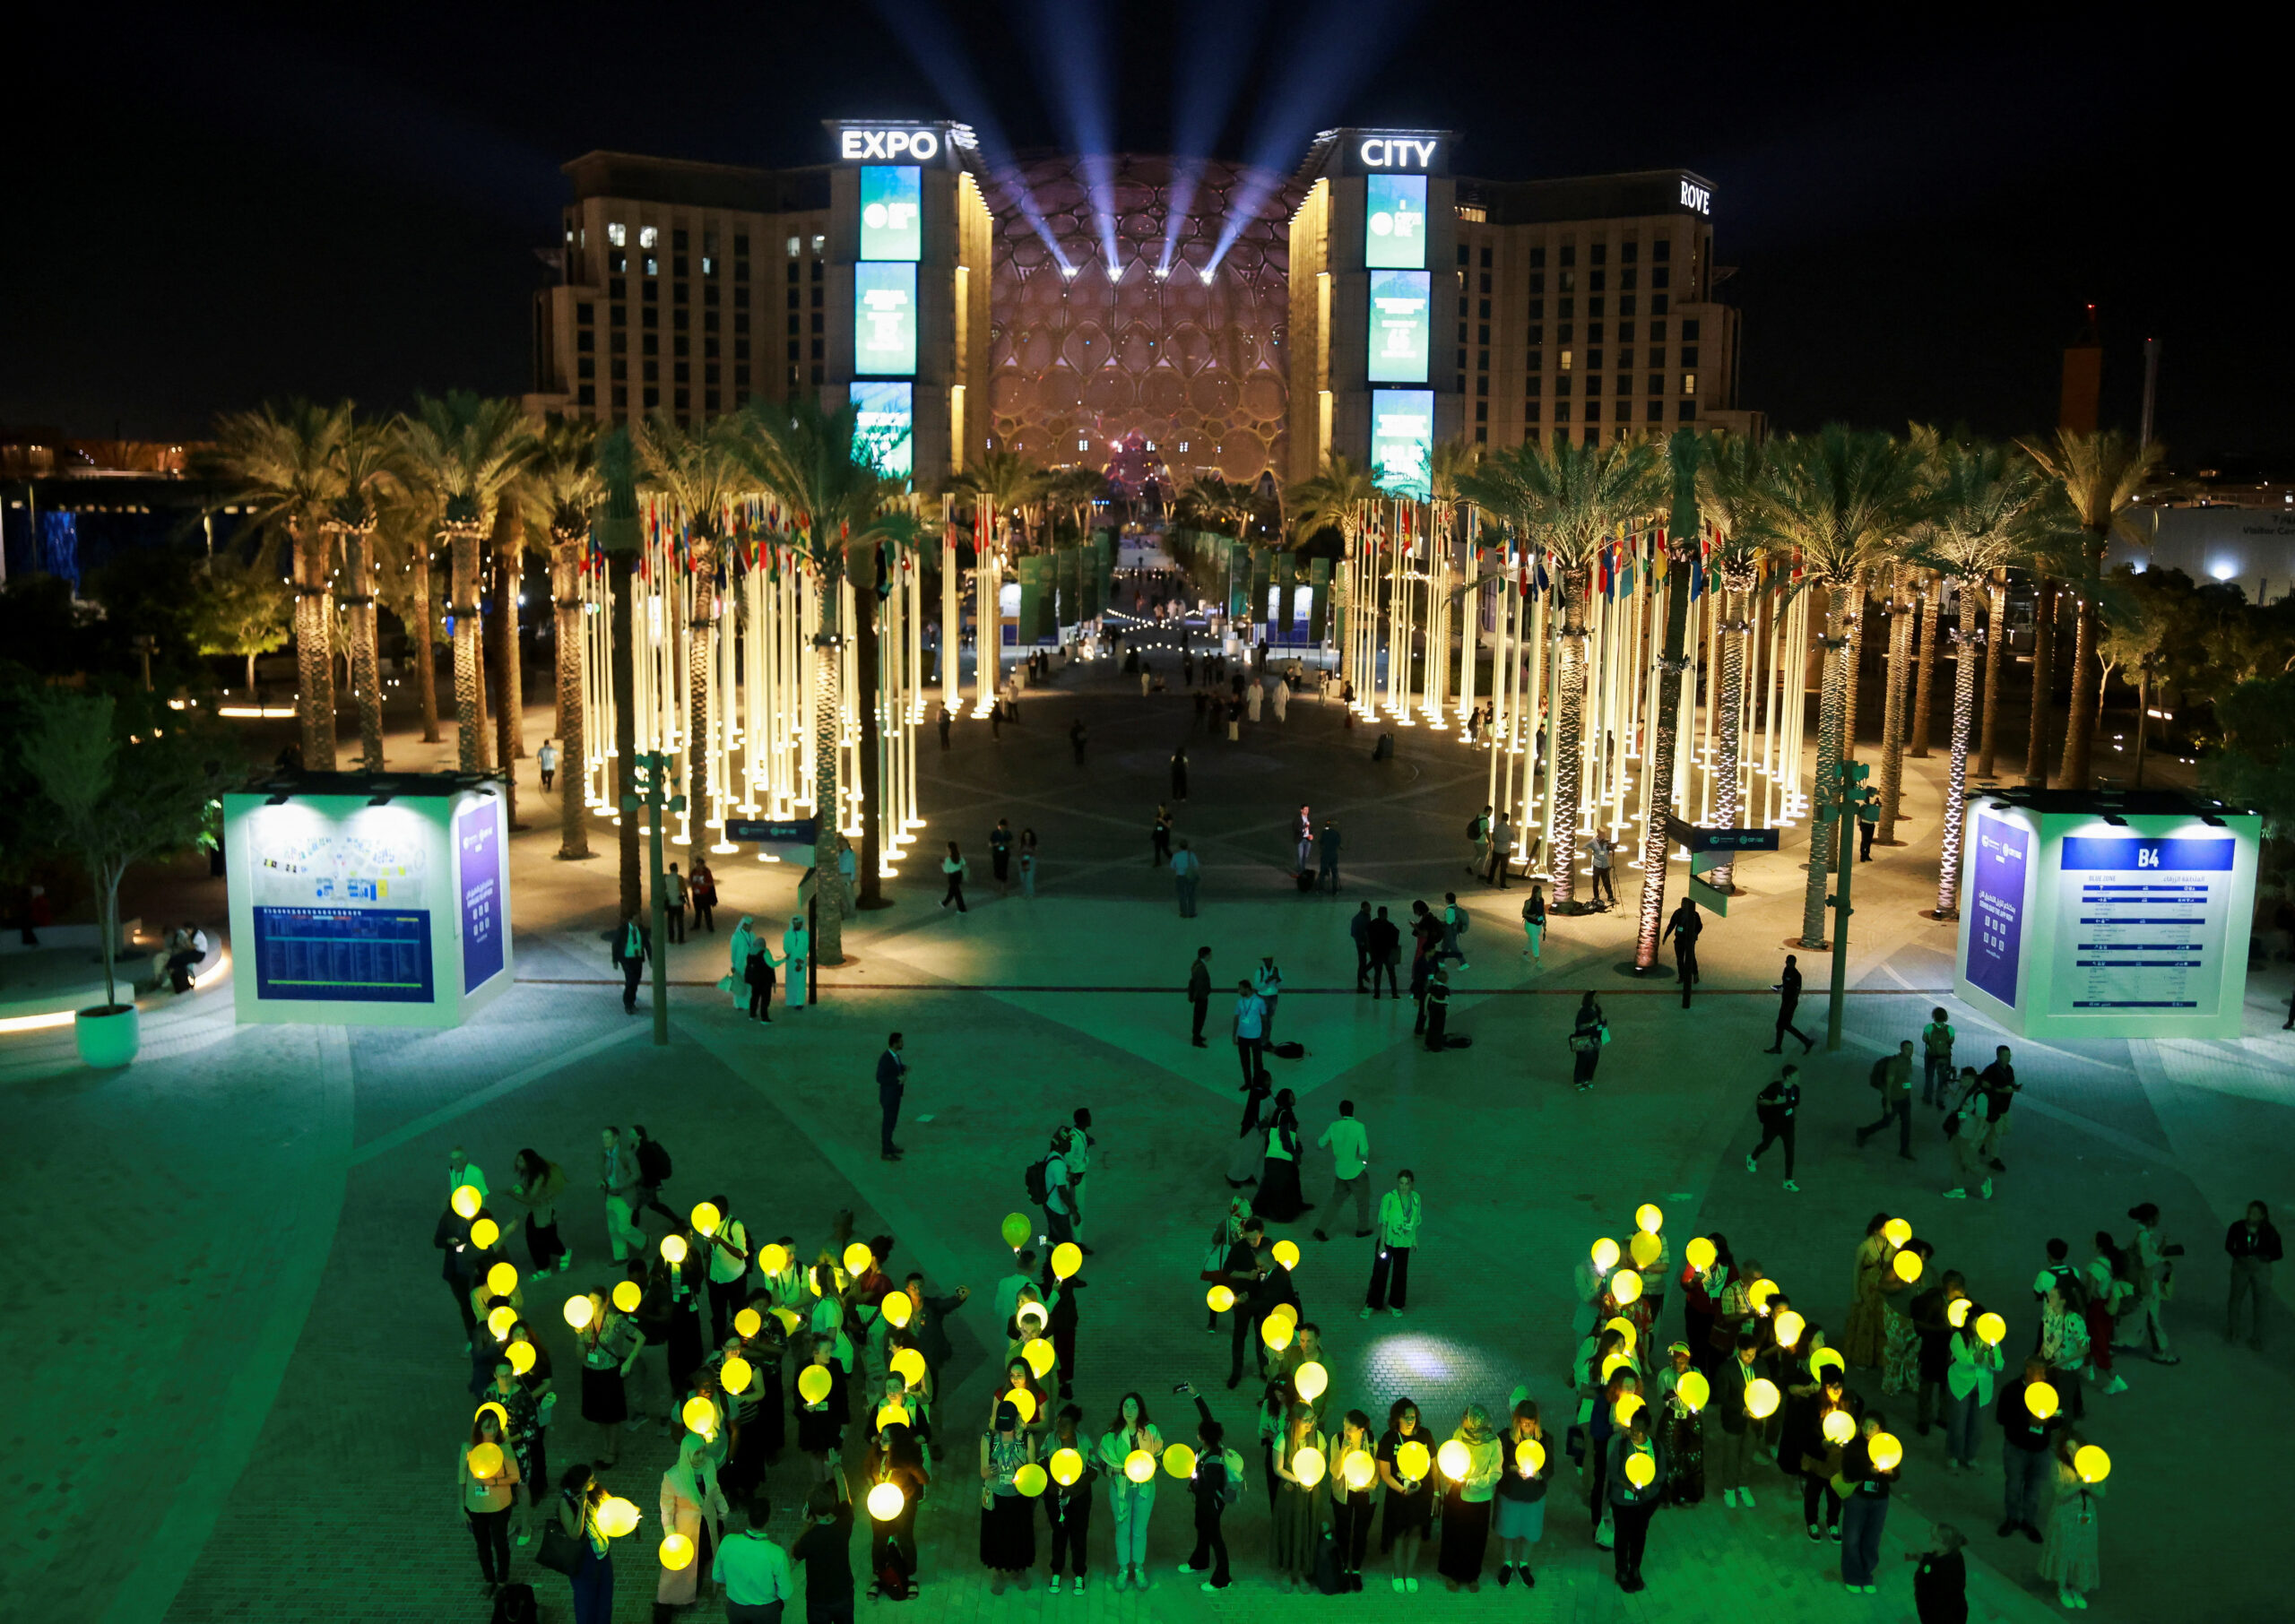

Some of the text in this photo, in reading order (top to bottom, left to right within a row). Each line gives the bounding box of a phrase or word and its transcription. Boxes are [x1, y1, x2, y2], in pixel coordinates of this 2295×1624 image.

[842, 131, 938, 160] EXPO
[1361, 139, 1436, 168] CITY
[1681, 181, 1710, 215] ROVE
[2243, 525, 2275, 535] Visitor
[2137, 848, 2160, 868] B4
